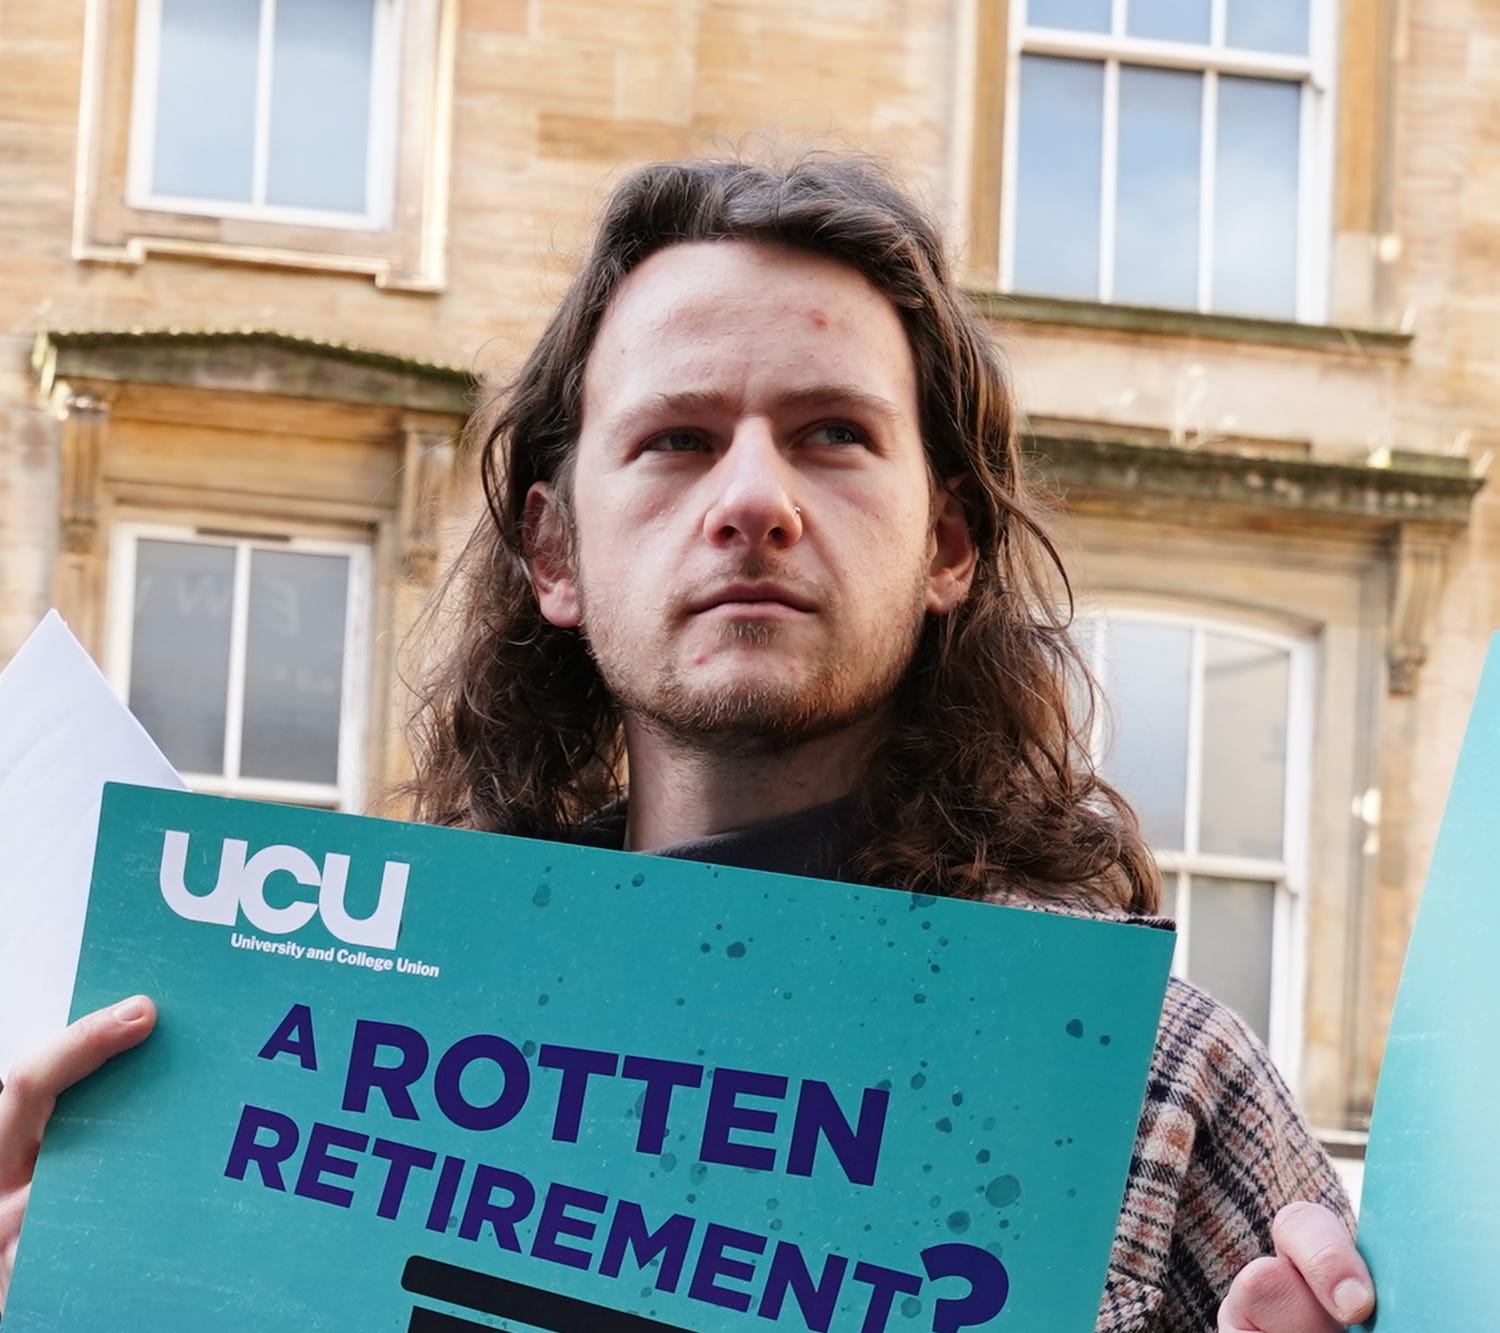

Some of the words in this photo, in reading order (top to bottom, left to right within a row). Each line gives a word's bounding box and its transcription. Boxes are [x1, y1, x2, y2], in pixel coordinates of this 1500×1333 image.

[159, 829, 411, 950] UCU
[230, 932, 304, 960] University
[307, 945, 335, 963] and
[337, 948, 394, 972] College
[396, 958, 440, 979] Union
[258, 1003, 319, 1072] A
[340, 1018, 890, 1188] ROTTEN
